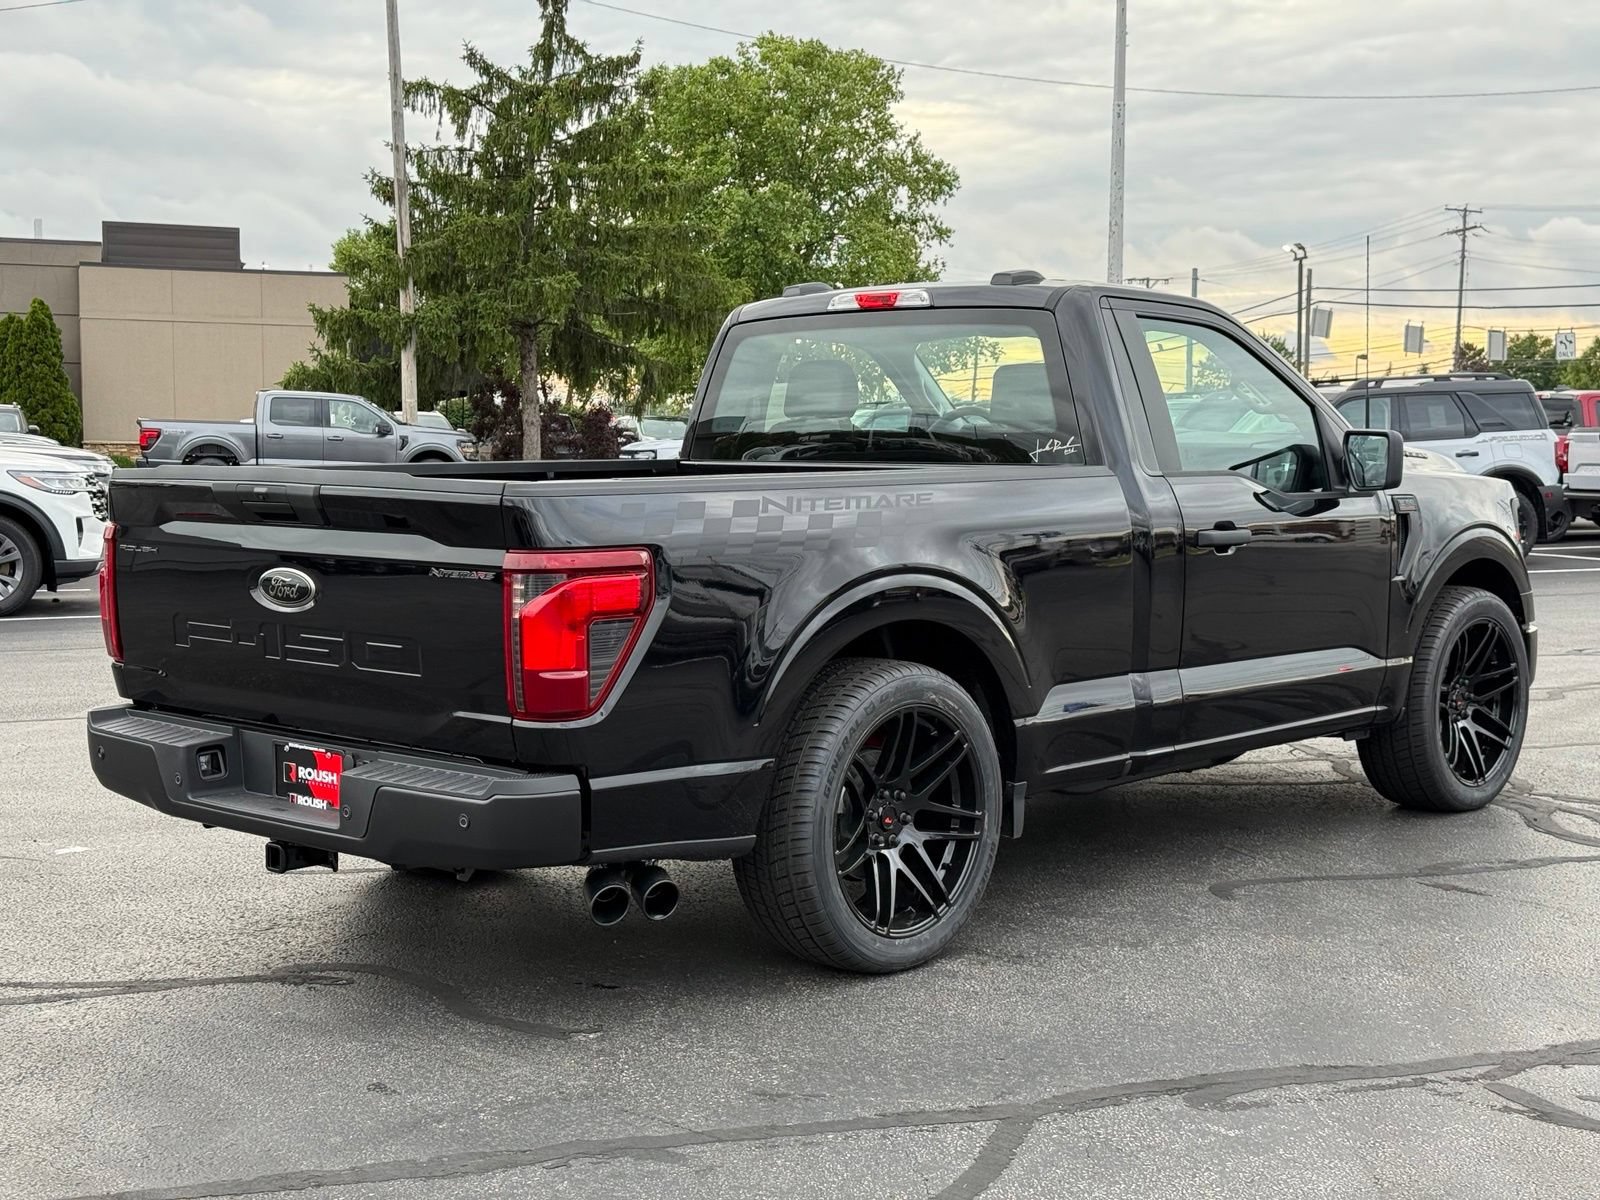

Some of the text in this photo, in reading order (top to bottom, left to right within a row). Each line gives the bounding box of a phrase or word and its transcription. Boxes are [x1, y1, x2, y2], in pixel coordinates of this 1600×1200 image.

[761, 491, 935, 515] NITEMARE
[268, 575, 300, 599] Ford
[173, 612, 422, 677] F-150
[823, 719, 862, 799] GENERAL
[298, 766, 338, 785] ROUSH
[297, 795, 328, 810] ROUSH
